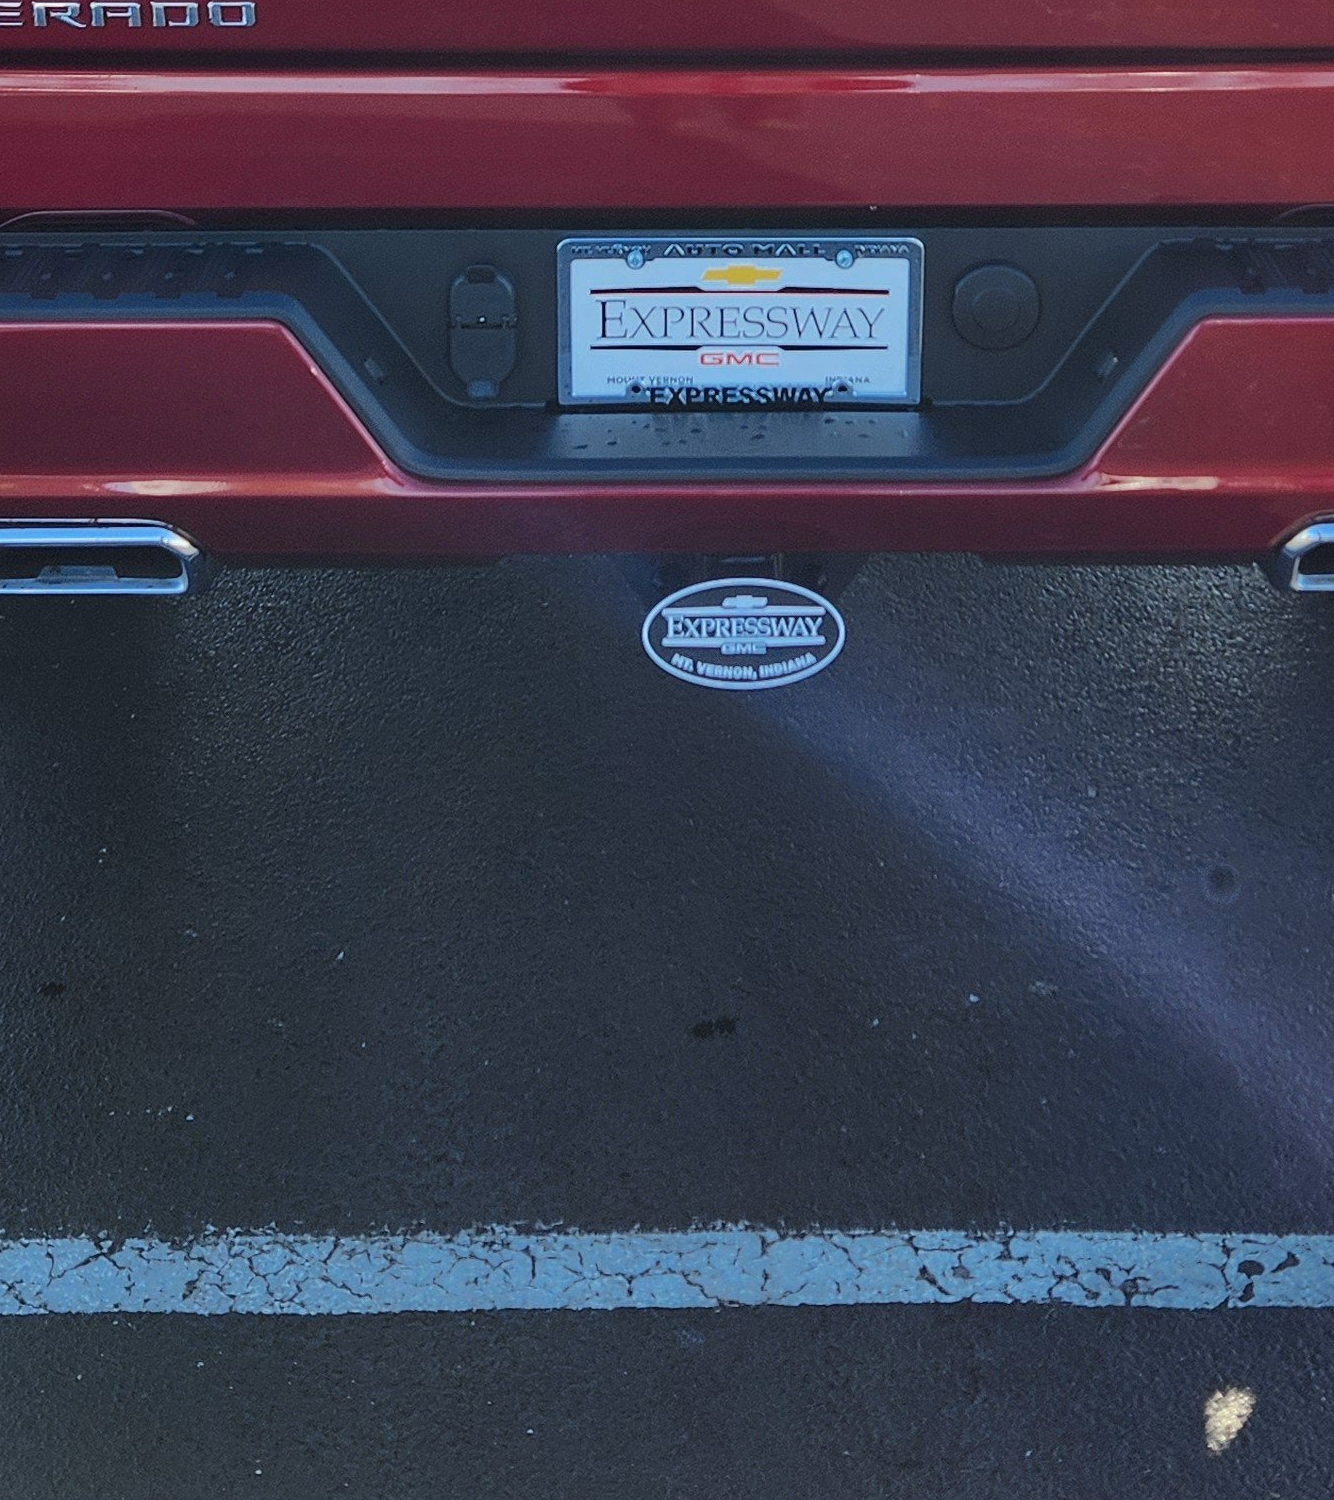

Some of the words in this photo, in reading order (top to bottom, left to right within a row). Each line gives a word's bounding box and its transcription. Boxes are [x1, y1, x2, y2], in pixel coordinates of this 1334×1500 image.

[663, 243, 745, 257] AUTO
[751, 243, 827, 257] MALL
[594, 299, 886, 340] EXPRESSWAY
[699, 352, 781, 366] GMC
[649, 386, 830, 404] EXPRESSWAY
[667, 615, 823, 638] EXPRESSWAY
[758, 651, 817, 678] INDIANA
